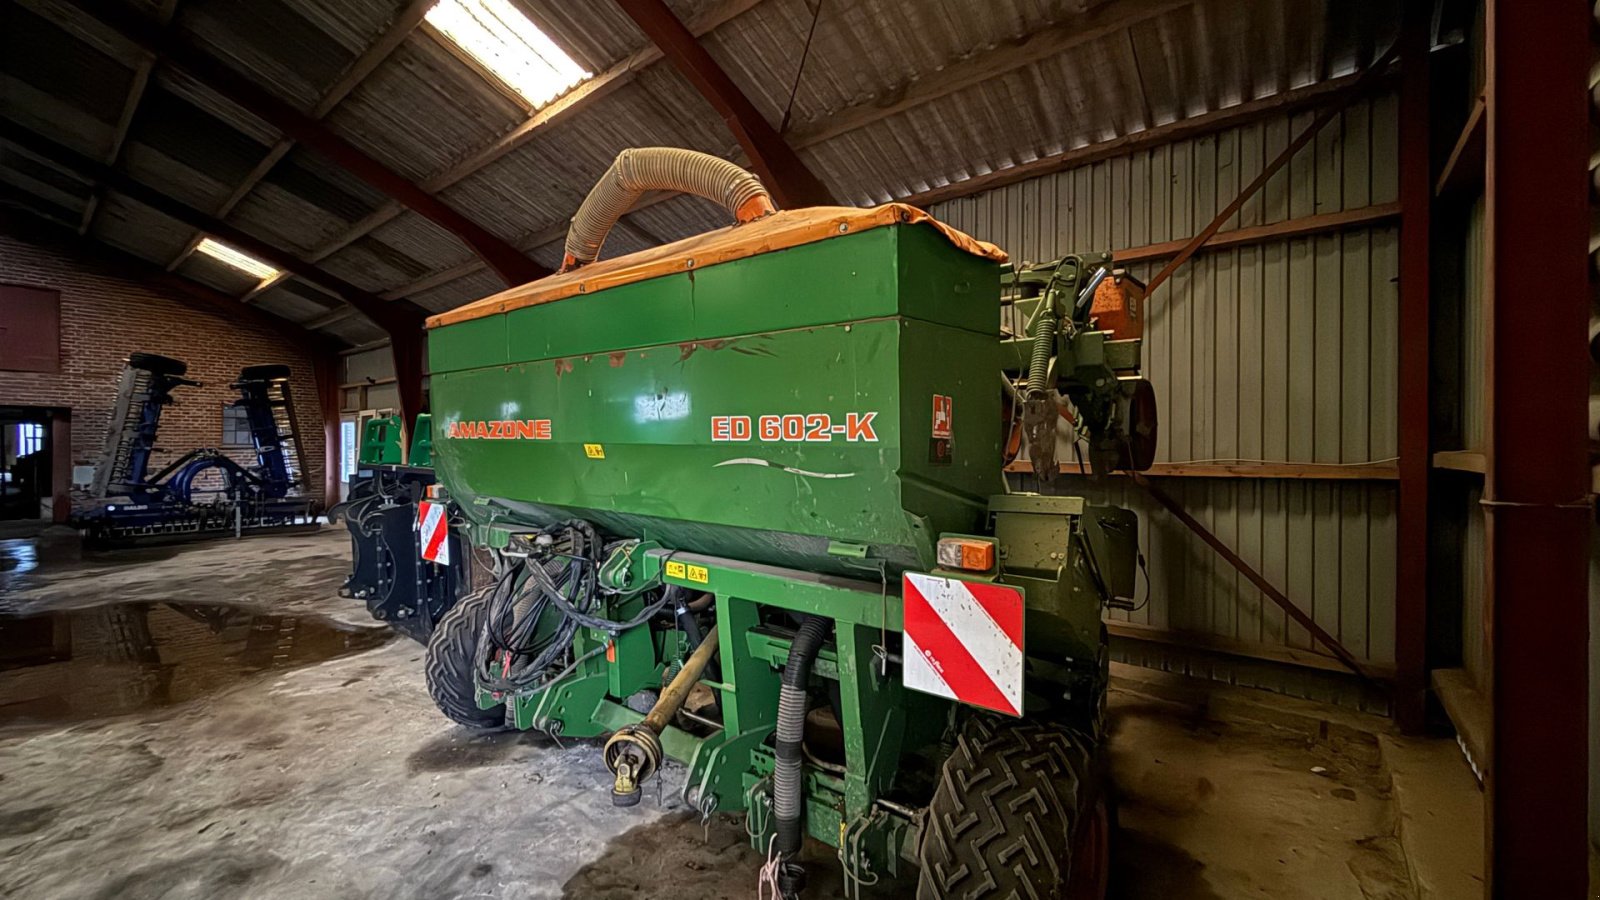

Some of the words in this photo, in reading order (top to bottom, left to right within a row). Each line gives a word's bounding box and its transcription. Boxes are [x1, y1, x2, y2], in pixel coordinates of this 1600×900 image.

[447, 419, 552, 440] AMAZONE
[711, 415, 752, 442] ED
[759, 411, 879, 442] 602-K
